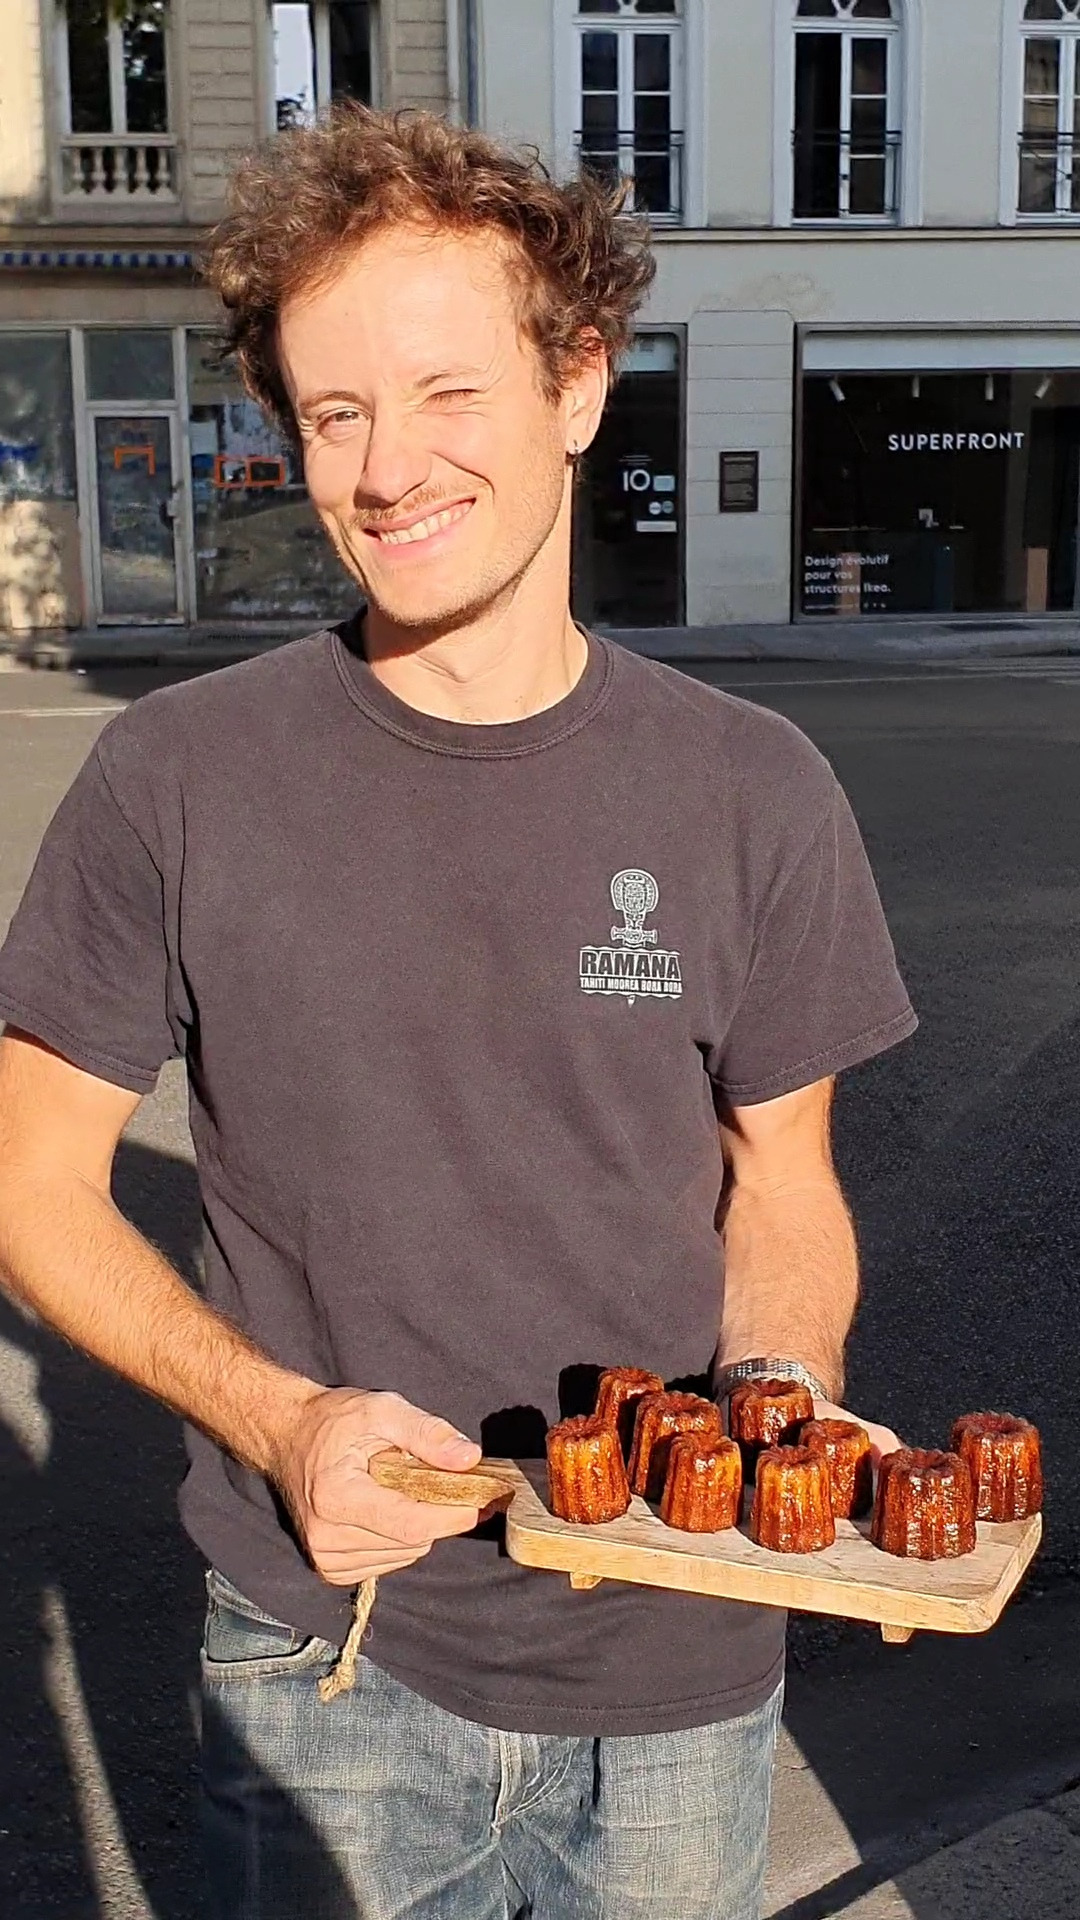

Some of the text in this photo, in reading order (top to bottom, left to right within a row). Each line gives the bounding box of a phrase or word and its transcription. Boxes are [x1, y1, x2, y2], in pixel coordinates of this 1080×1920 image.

[888, 432, 1025, 451] SUPERFRONT
[623, 469, 650, 492] 10
[804, 555, 843, 568] Design
[804, 571, 853, 582] pour vos
[804, 584, 861, 594] structures
[580, 951, 681, 980] RAMANA
[580, 977, 682, 994] TAHITI MOOREA BORA BORA
